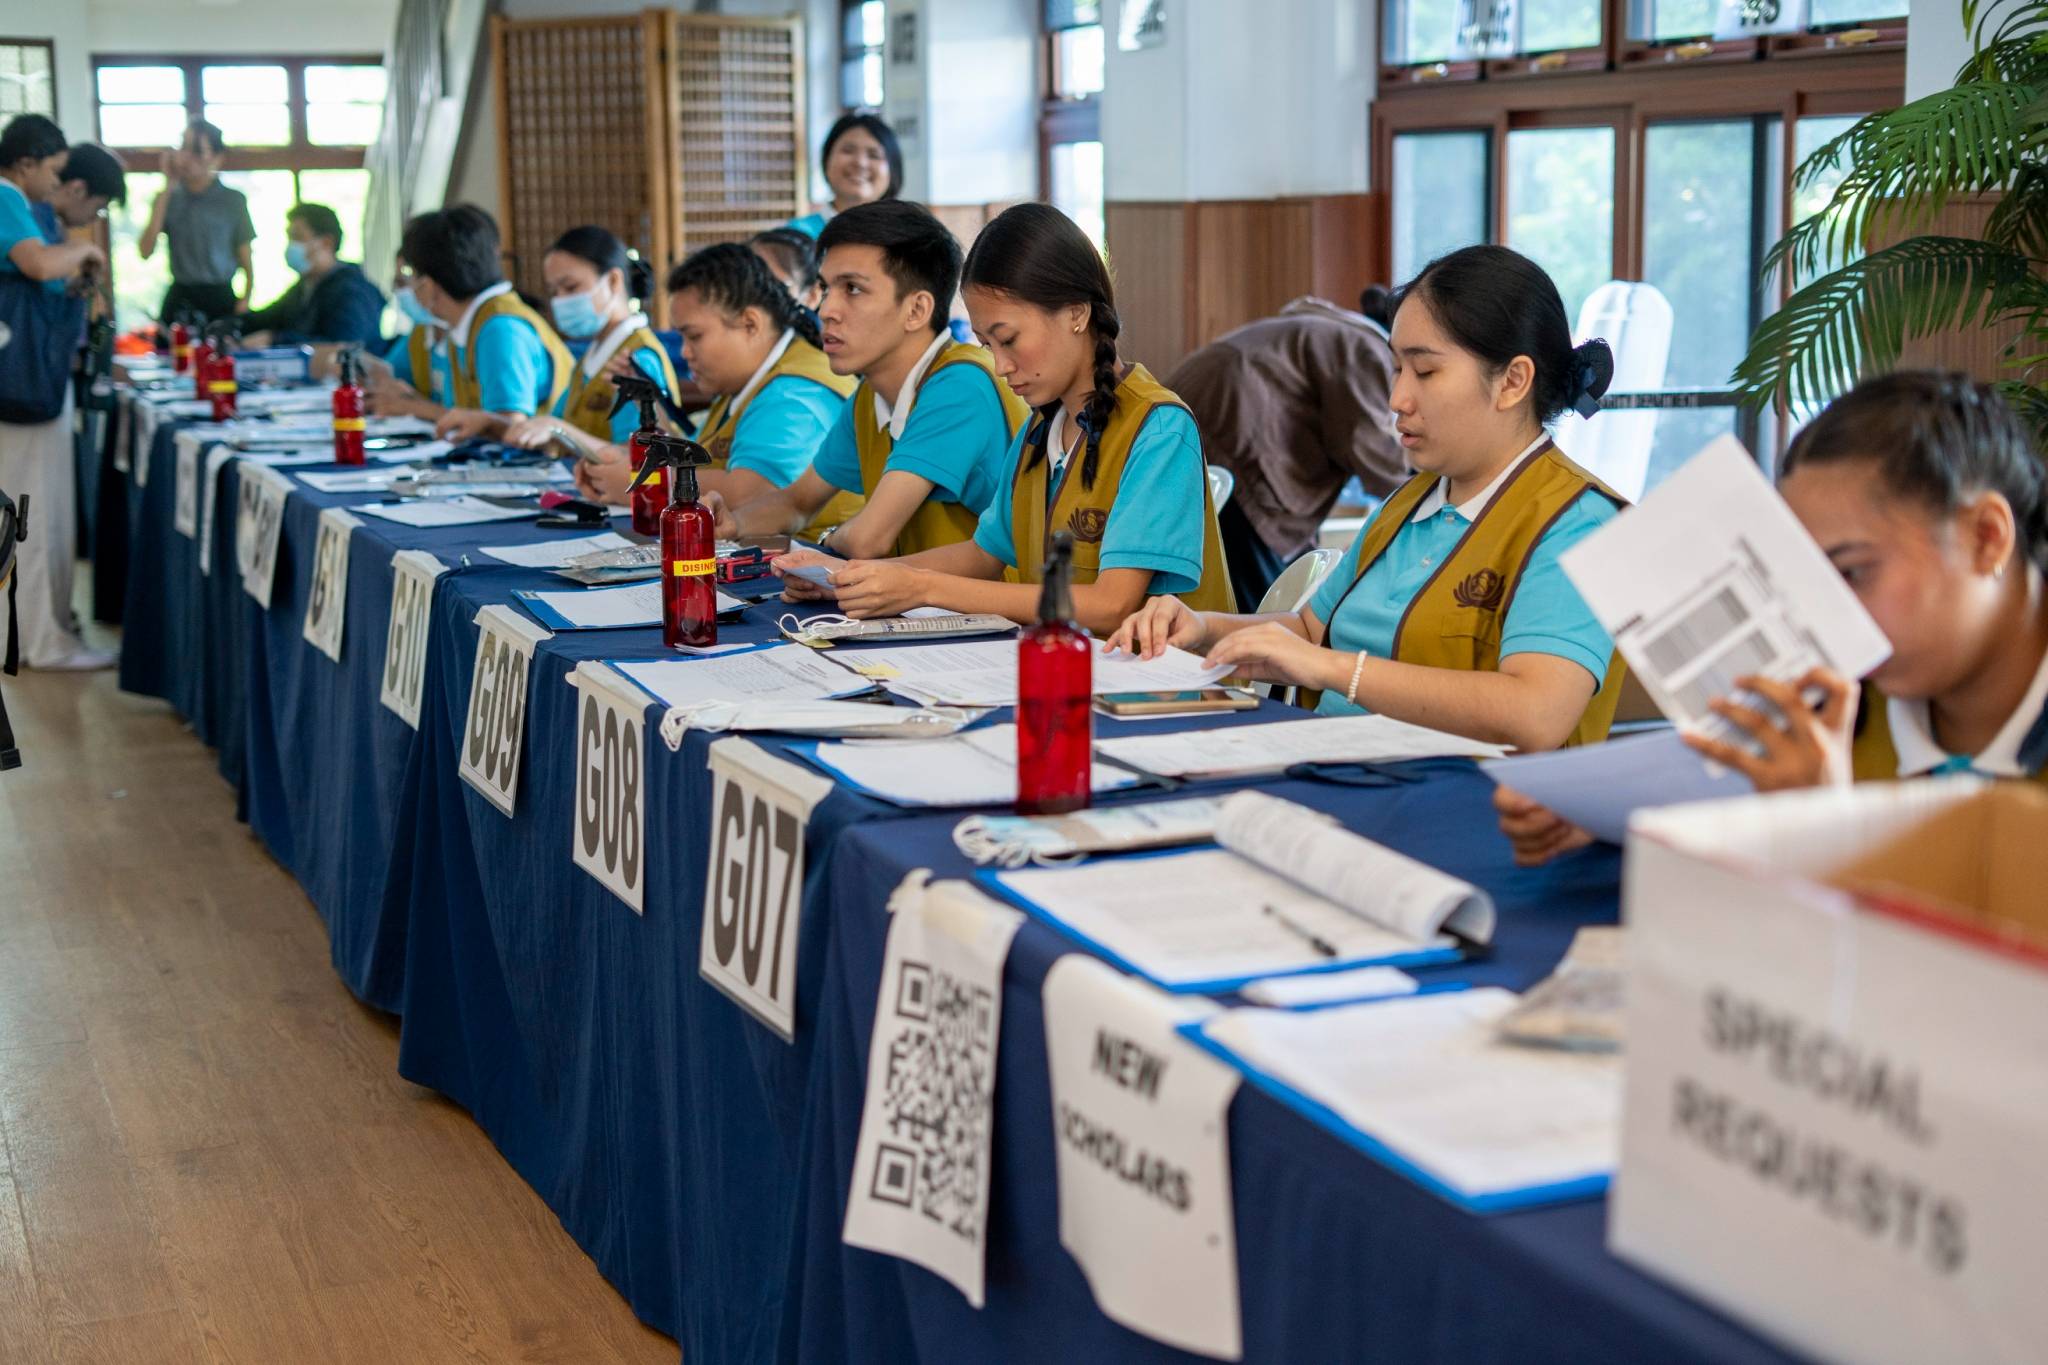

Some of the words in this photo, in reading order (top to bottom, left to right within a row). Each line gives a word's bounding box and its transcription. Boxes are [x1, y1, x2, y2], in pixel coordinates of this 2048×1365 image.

[388, 571, 427, 707] G10
[469, 630, 524, 793] G09
[580, 694, 640, 890] G08
[713, 778, 799, 1002] G07
[1092, 1026, 1168, 1103] NEW
[1704, 985, 1934, 1147] SPECIAL
[1670, 1076, 1969, 1276] REQUESTS
